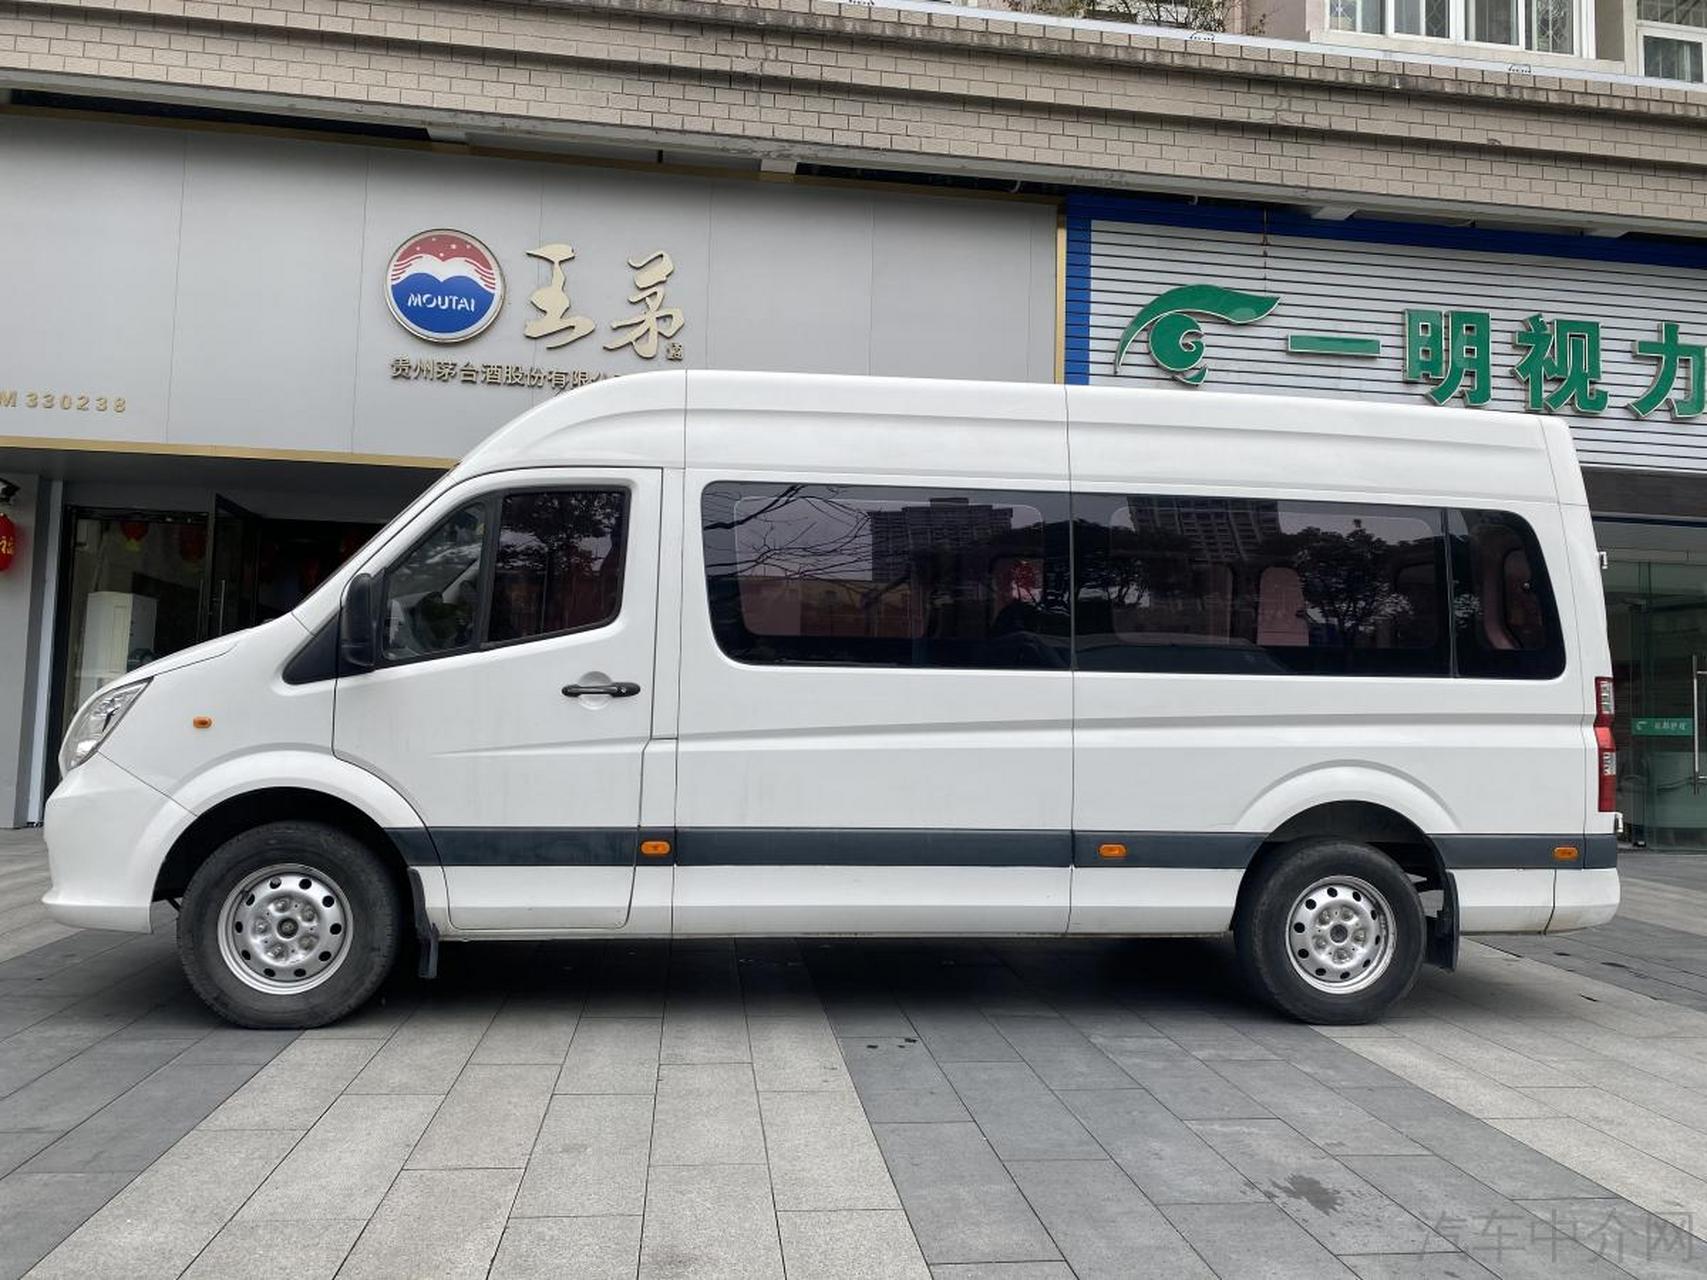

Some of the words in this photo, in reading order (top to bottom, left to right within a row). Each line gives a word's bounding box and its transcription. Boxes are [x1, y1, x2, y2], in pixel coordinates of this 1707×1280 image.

[407, 293, 474, 312] MOUTAI
[391, 355, 621, 390] 贵州茅台酒股份有限
[1287, 309, 1706, 420] 一明视力
[26, 393, 126, 413] 330238
